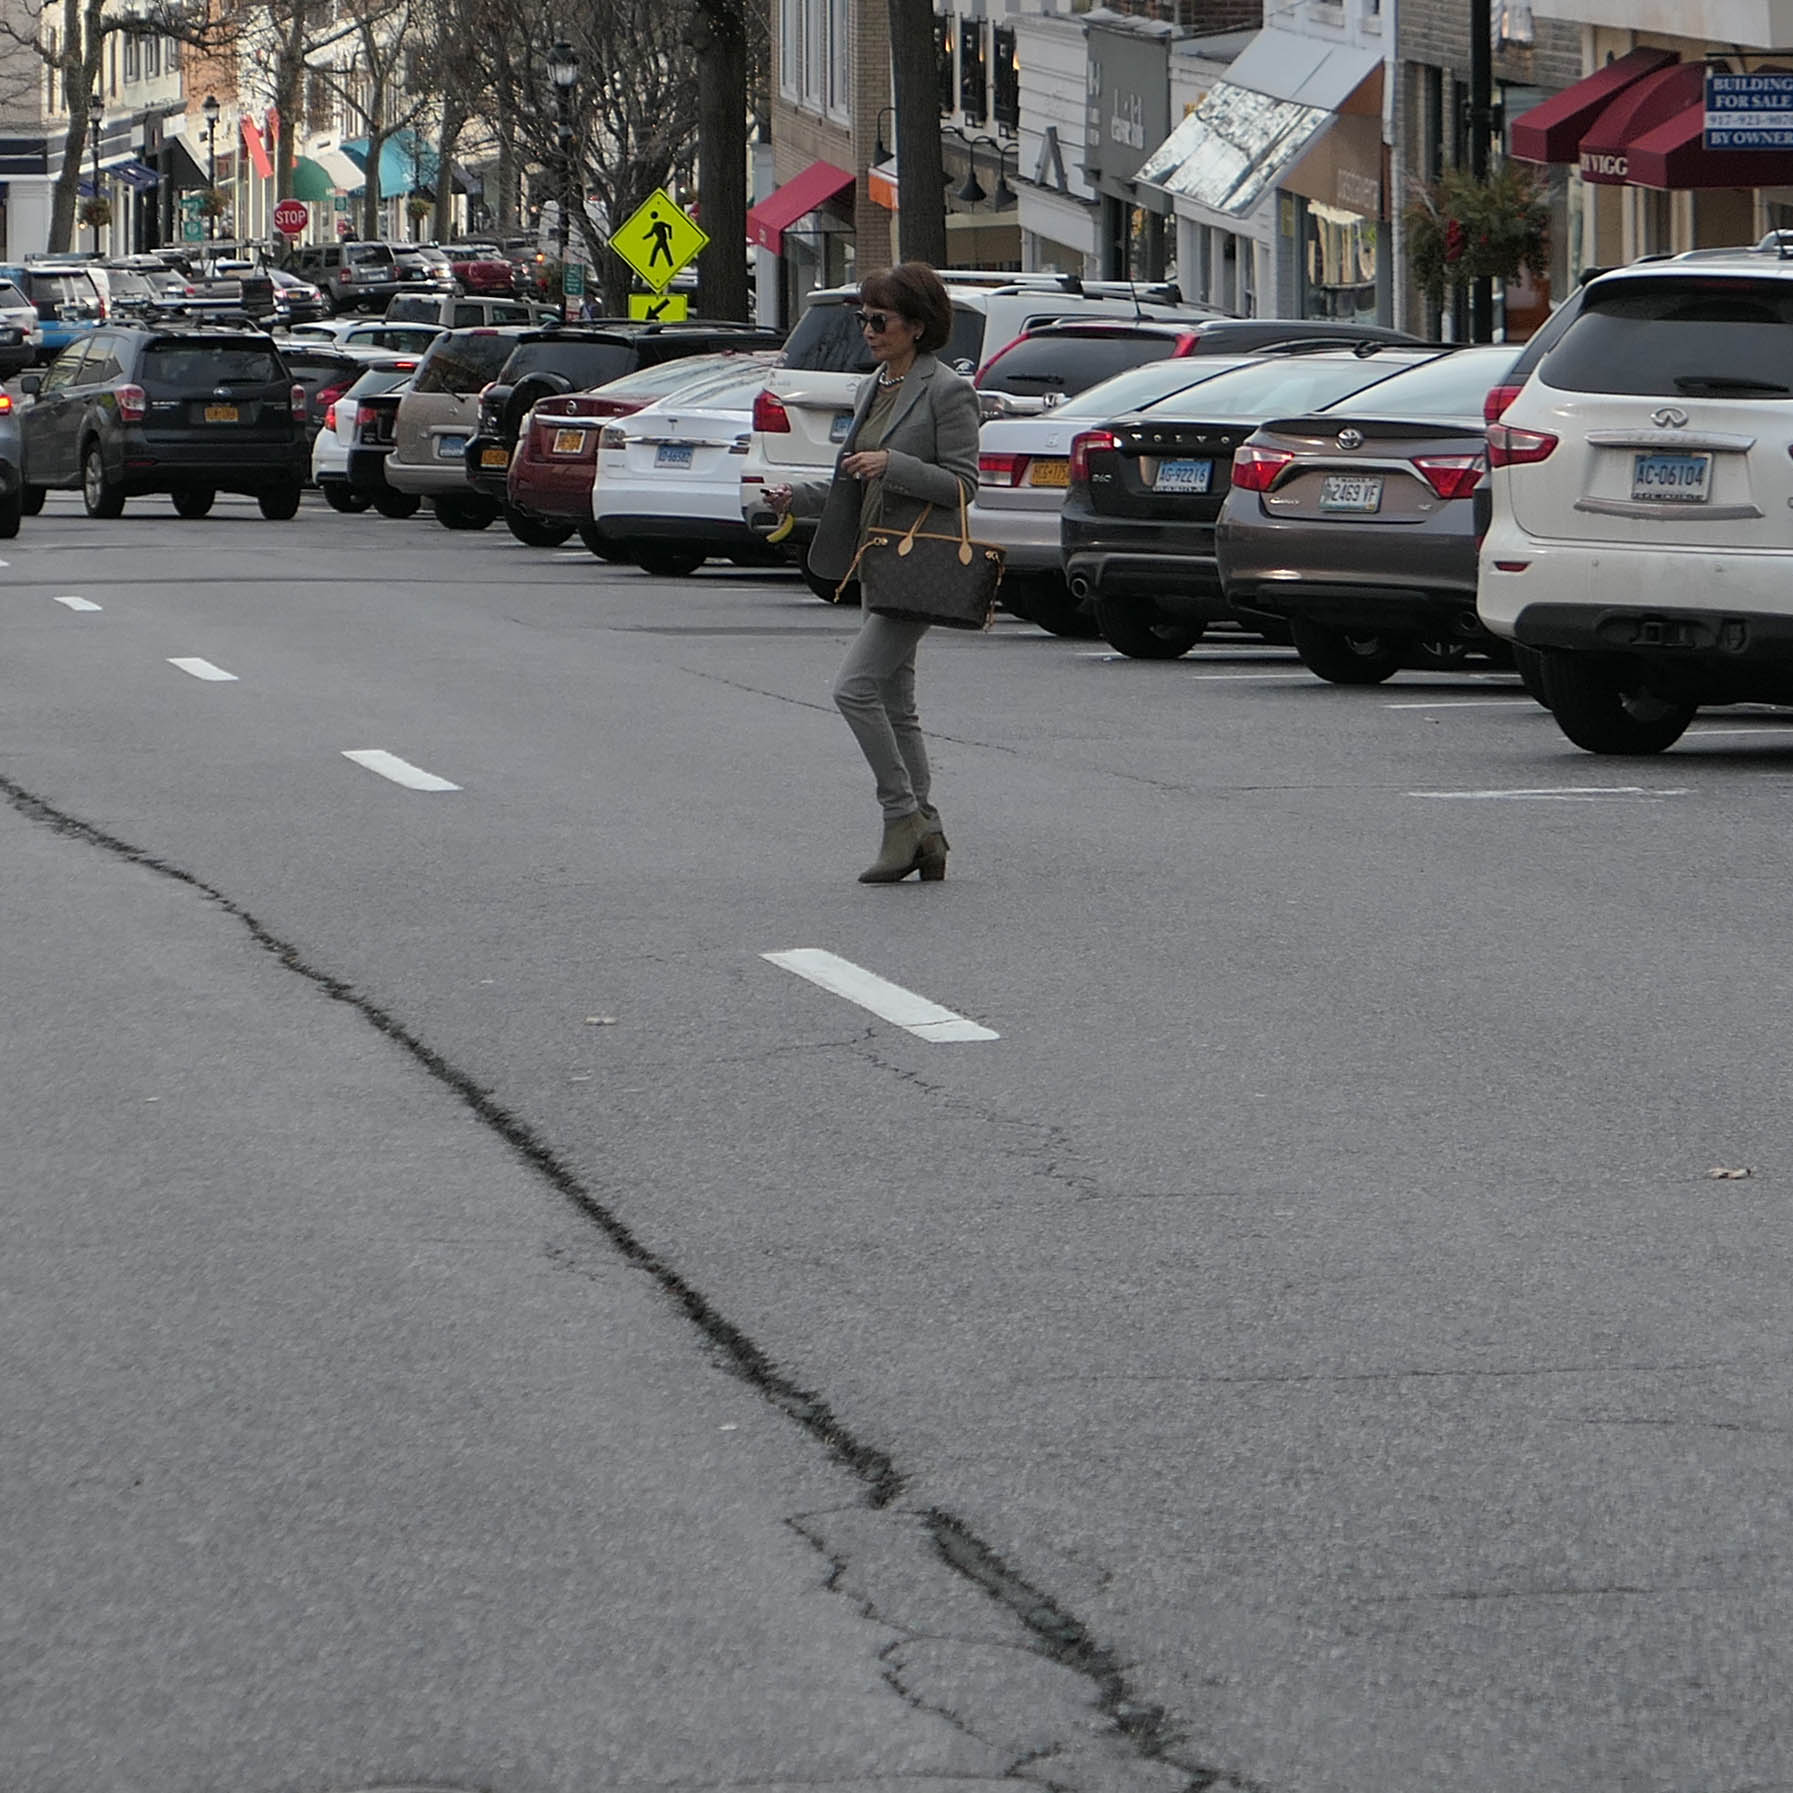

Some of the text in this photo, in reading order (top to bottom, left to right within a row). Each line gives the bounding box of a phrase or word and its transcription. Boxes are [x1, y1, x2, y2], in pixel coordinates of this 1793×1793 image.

[1715, 94, 1793, 108] FOR SALE
[1711, 131, 1730, 145] BY
[275, 210, 306, 225] STOP
[1130, 433, 1230, 444] VOLVO
